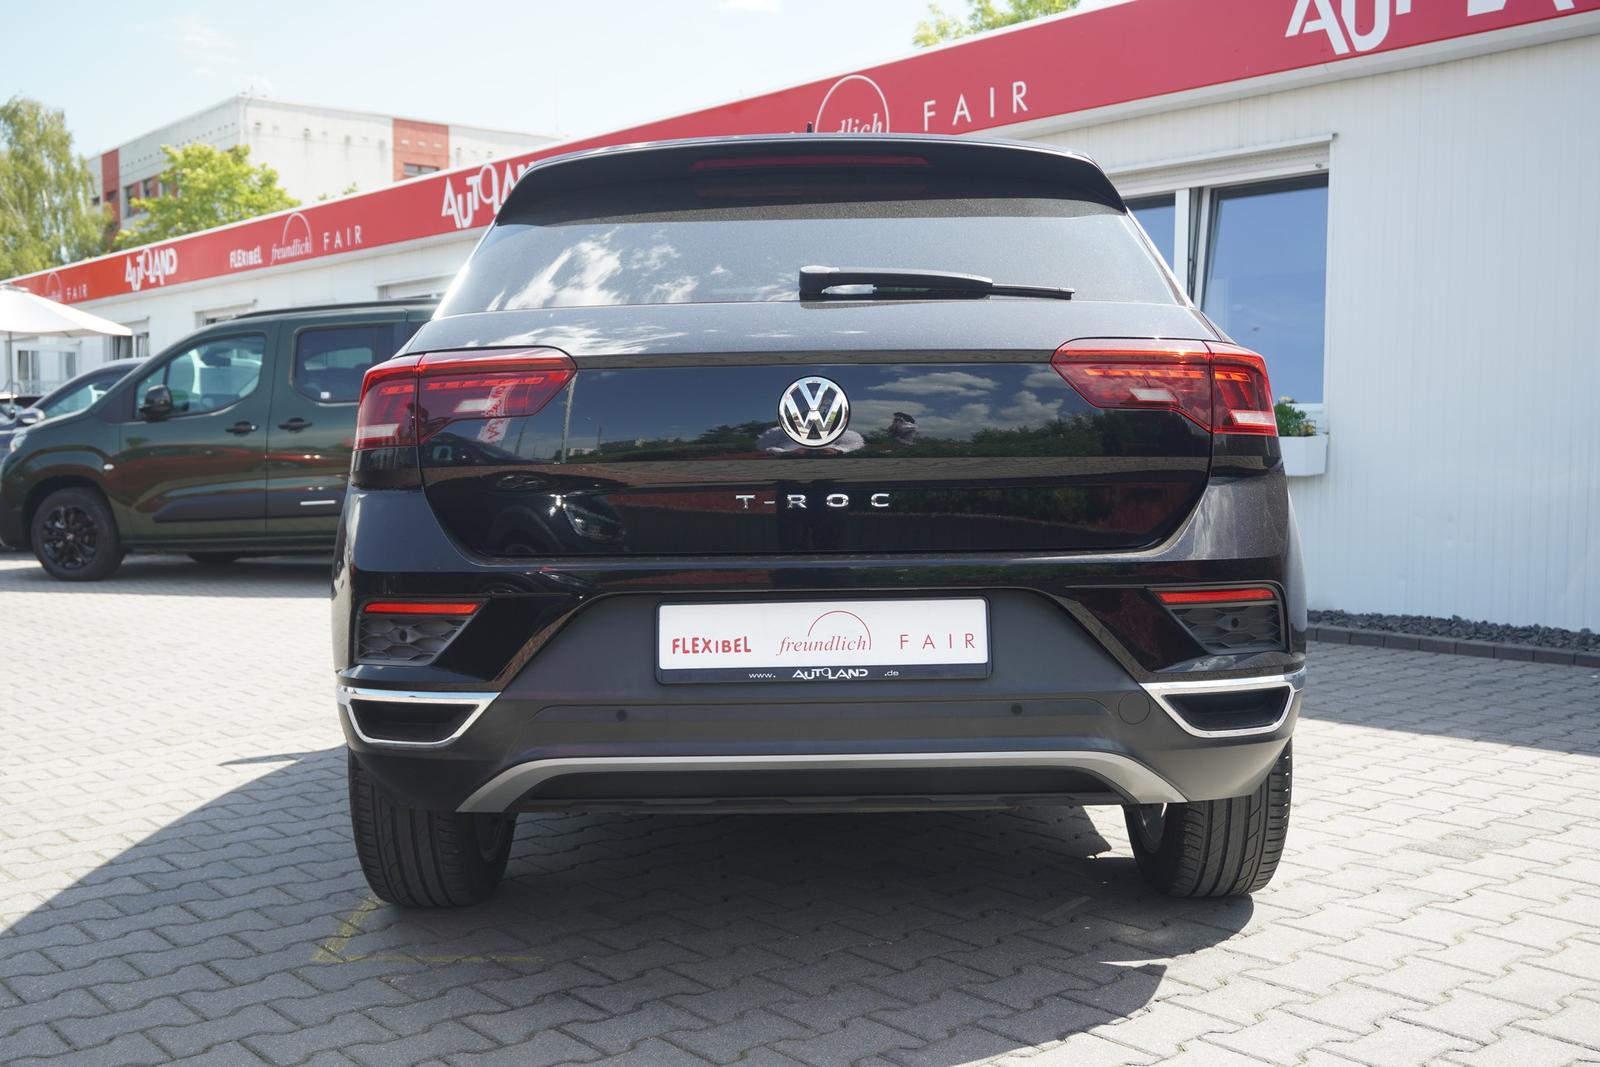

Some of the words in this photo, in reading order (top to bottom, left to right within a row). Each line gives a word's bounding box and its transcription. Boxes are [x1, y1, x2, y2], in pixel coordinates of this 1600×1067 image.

[923, 80, 1029, 132] FAIR
[441, 162, 535, 229] AUTOLA
[229, 244, 263, 269] FLEXIBEL
[323, 224, 363, 251] FAIR
[125, 247, 178, 291] AUTOLAND
[778, 376, 850, 447] VW
[735, 493, 891, 509] T-ROC
[671, 636, 752, 655] FLEXIBEL
[775, 633, 868, 657] freundlich
[899, 632, 976, 650] FAIR
[792, 667, 869, 681] AUTOLAND
